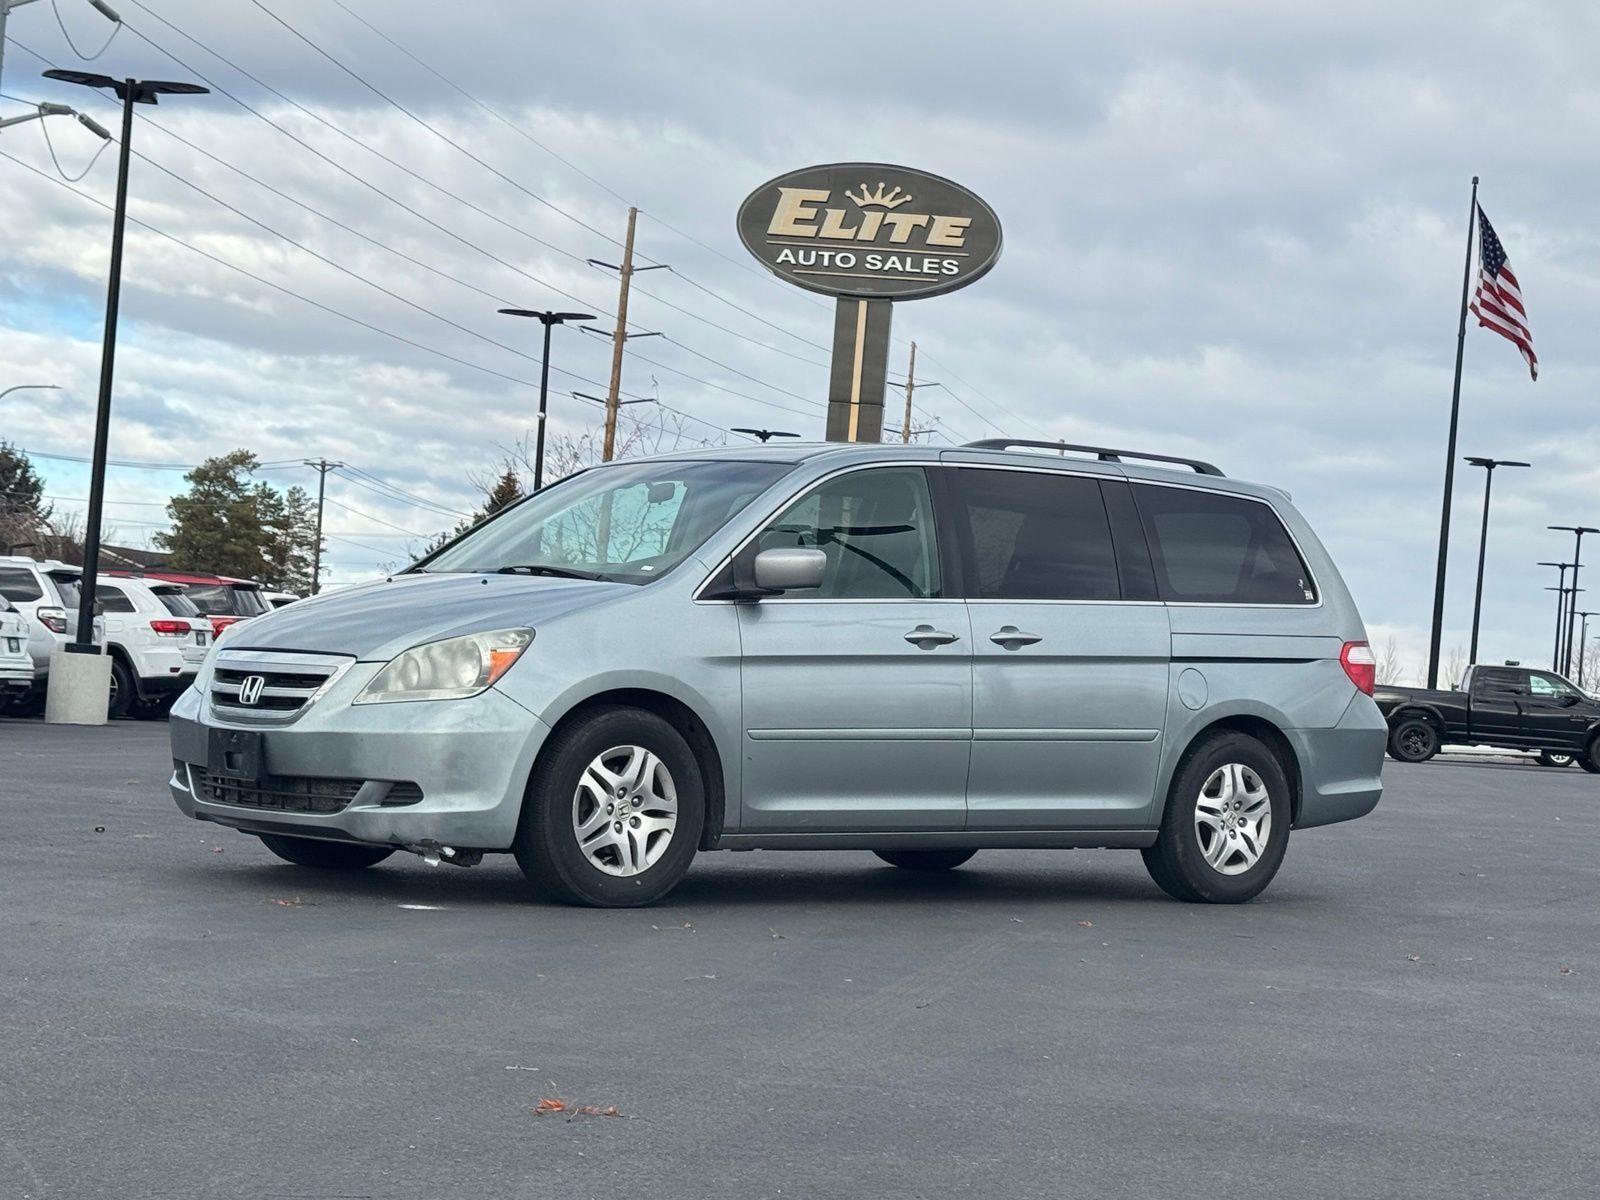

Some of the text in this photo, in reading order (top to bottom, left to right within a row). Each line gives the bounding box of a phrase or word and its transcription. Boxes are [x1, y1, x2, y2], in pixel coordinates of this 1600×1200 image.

[767, 187, 972, 247] ELITE
[776, 249, 960, 275] AUTO SALES
